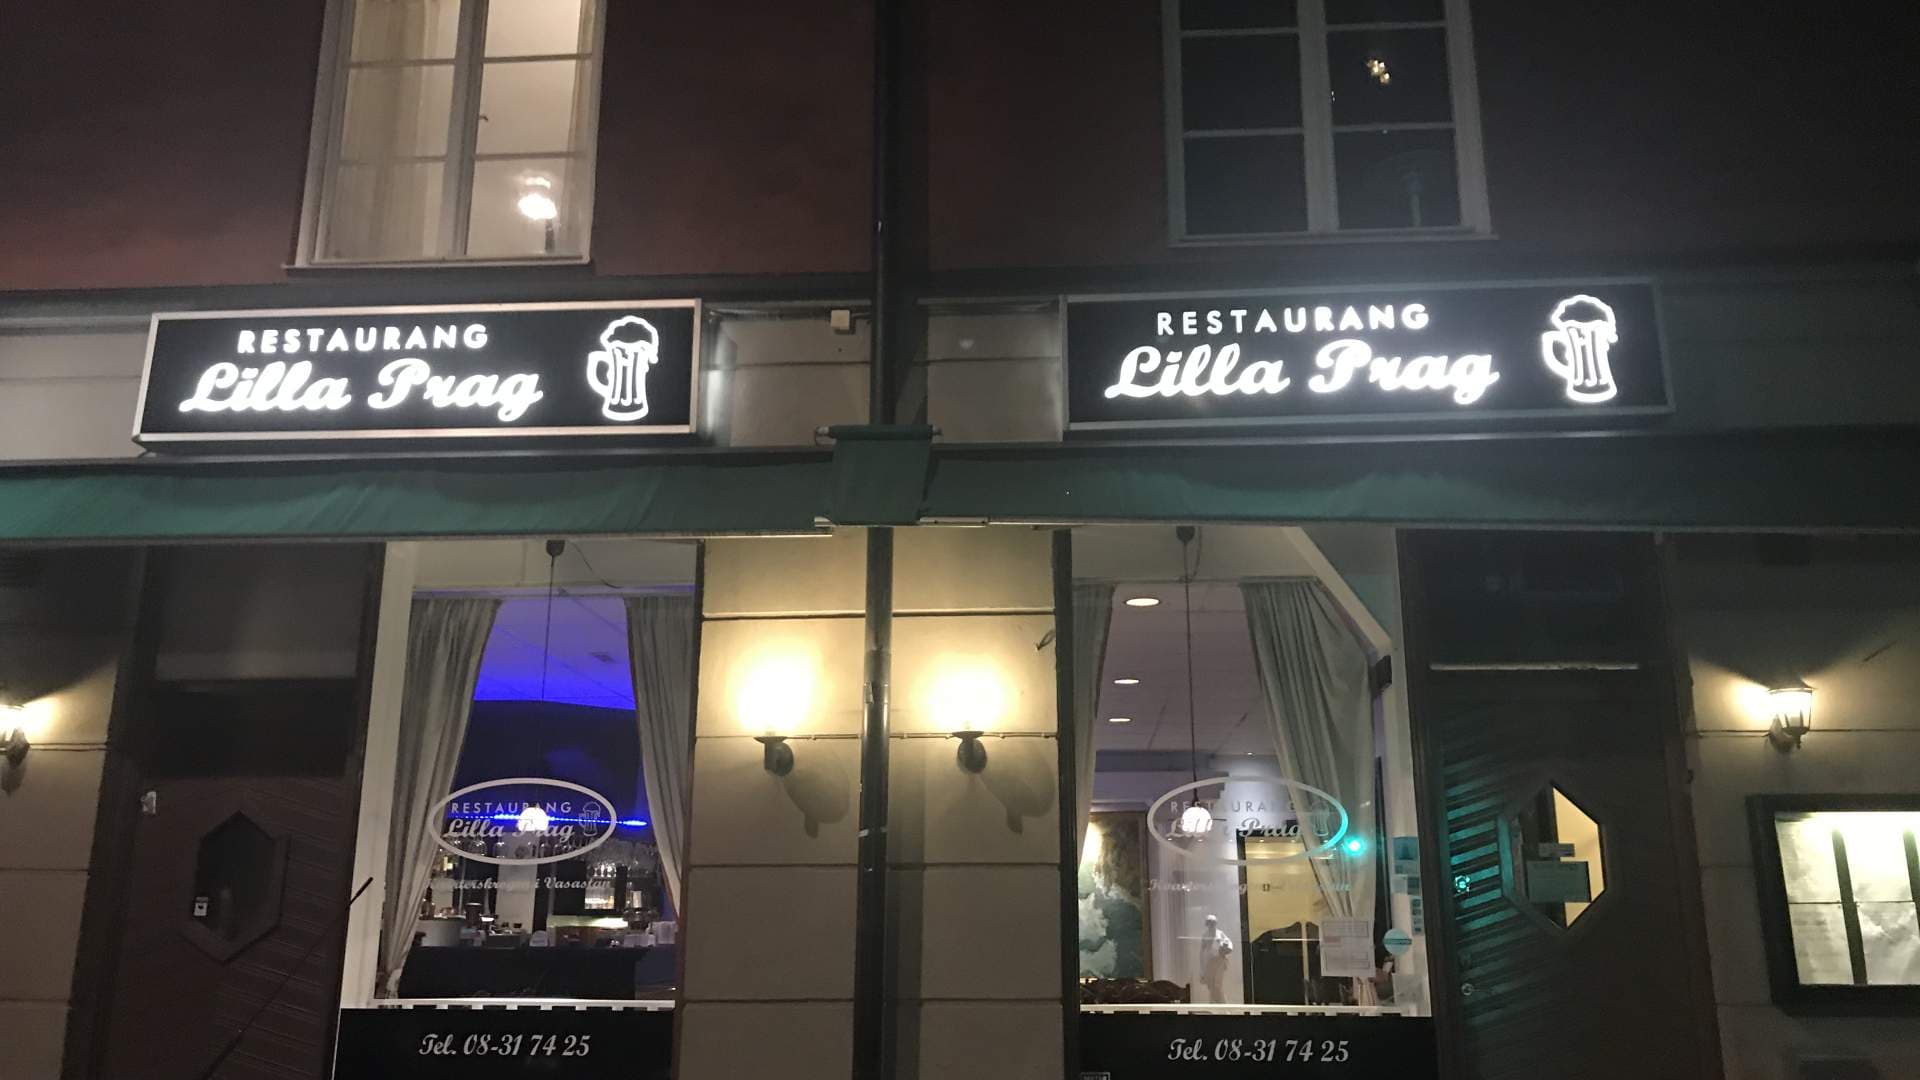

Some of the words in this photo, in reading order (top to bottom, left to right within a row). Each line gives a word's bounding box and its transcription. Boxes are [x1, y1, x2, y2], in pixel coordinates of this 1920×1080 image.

[1157, 303, 1430, 336] RESTAURANG
[237, 322, 488, 355] RESTAURANG
[1104, 342, 1291, 399] Lilla
[1308, 338, 1501, 405] Prag
[178, 360, 352, 412] Lilla
[367, 357, 544, 422] Prag
[443, 818, 505, 838] Lilla
[418, 1033, 457, 1055] Tel.
[463, 1034, 523, 1056] 08-31
[530, 1034, 557, 1056] 74
[561, 1034, 591, 1057] 25
[1167, 1038, 1208, 1061] Tel.
[1214, 1039, 1277, 1062] 08-31
[1285, 1039, 1314, 1062] 74
[1320, 1040, 1349, 1062] 25
